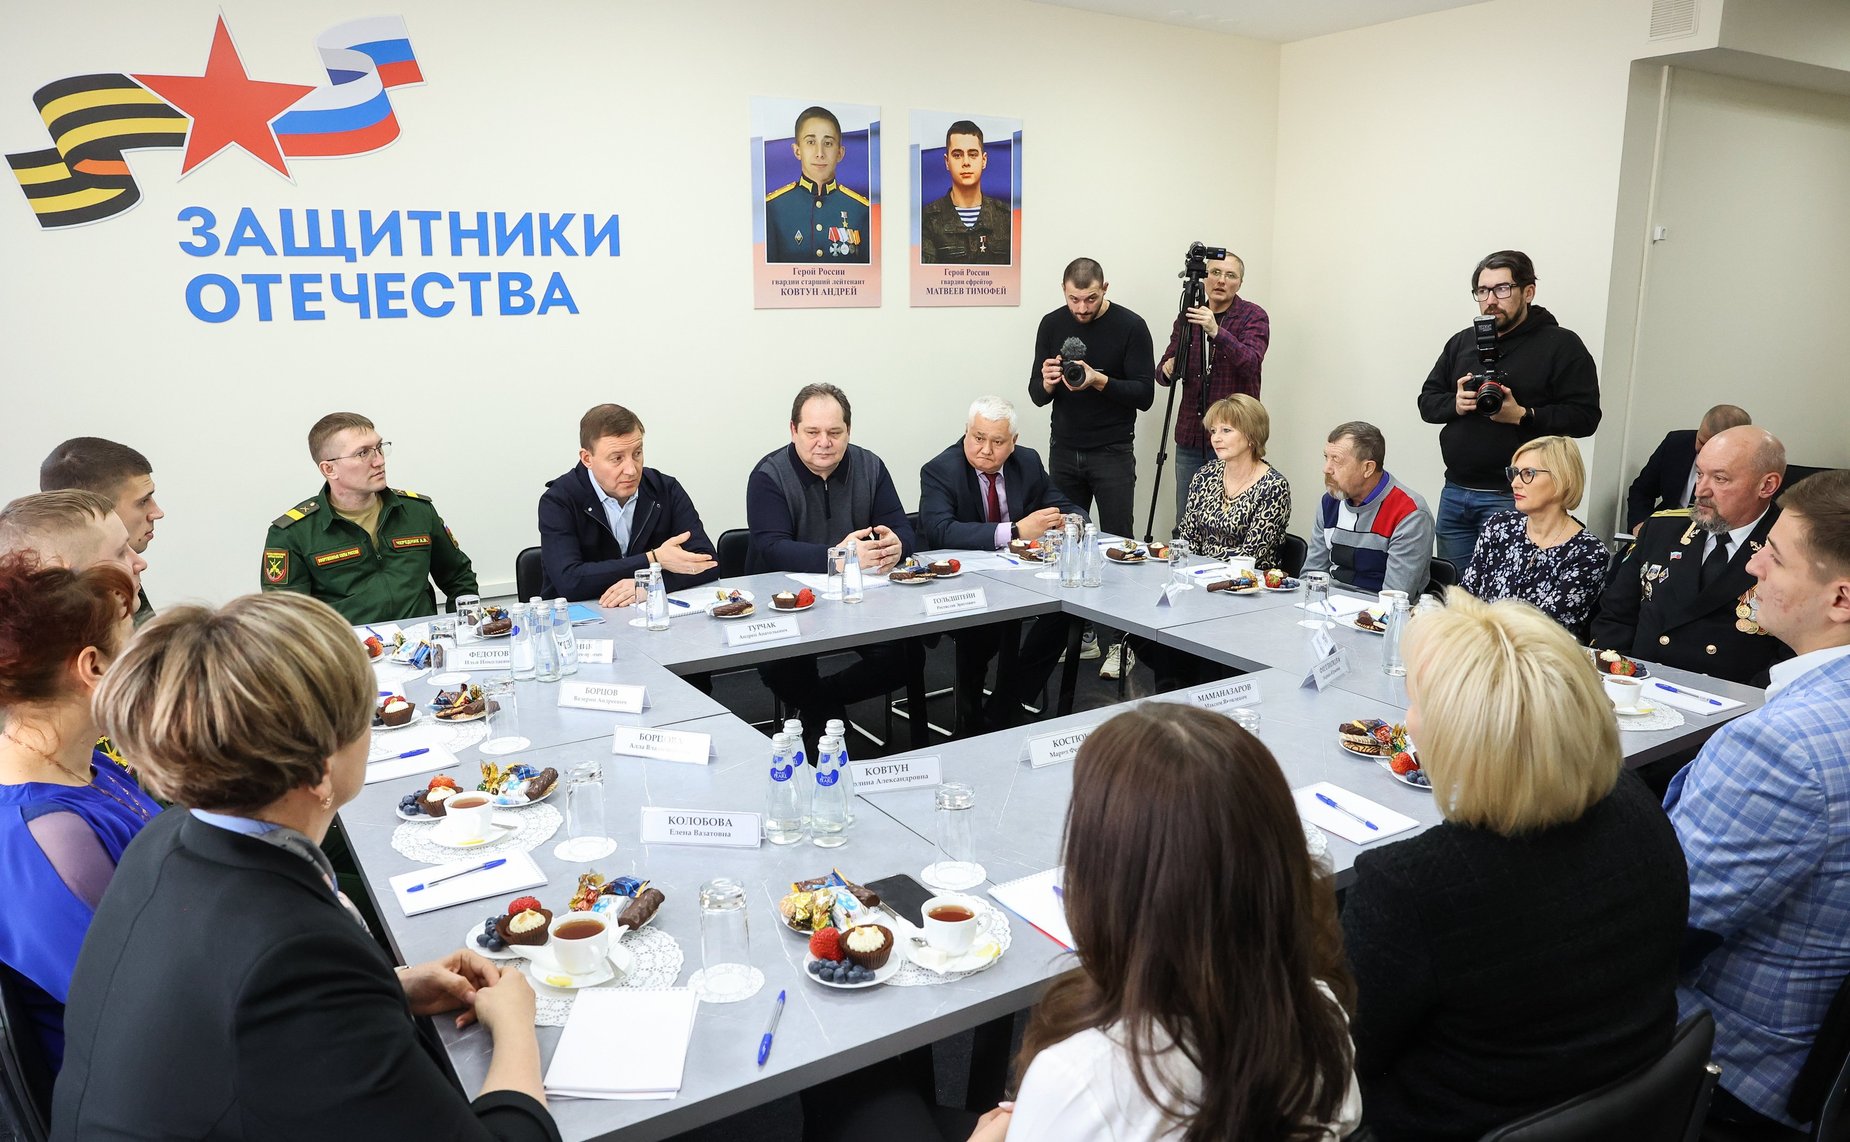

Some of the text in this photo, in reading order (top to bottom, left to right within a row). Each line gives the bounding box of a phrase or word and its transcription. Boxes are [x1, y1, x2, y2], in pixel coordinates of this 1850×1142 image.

[178, 206, 621, 262] ЗАЩИТНИКИ
[792, 267, 845, 277] Герой России
[944, 268, 990, 277] Герой России
[772, 277, 865, 287] гвардии старший лейтенант
[941, 279, 964, 287] гвардии
[781, 285, 857, 296] КОВТУН АНДРЕЙ
[926, 285, 1007, 296] МАТВЕЕВ ТИМОФЕЙ
[185, 272, 579, 323] ОТЕЧЕСТВА
[747, 622, 777, 632] ТУРЧАК
[469, 650, 509, 658] ФЕДОТОВ
[585, 687, 619, 697] БОРЦОВ
[1197, 684, 1252, 702] МАМАНАЗАРОВ
[865, 764, 909, 776] КОВТУН
[876, 774, 929, 785] Александровна
[668, 816, 733, 827] КОЛОБОВА
[669, 828, 692, 836] Елена
